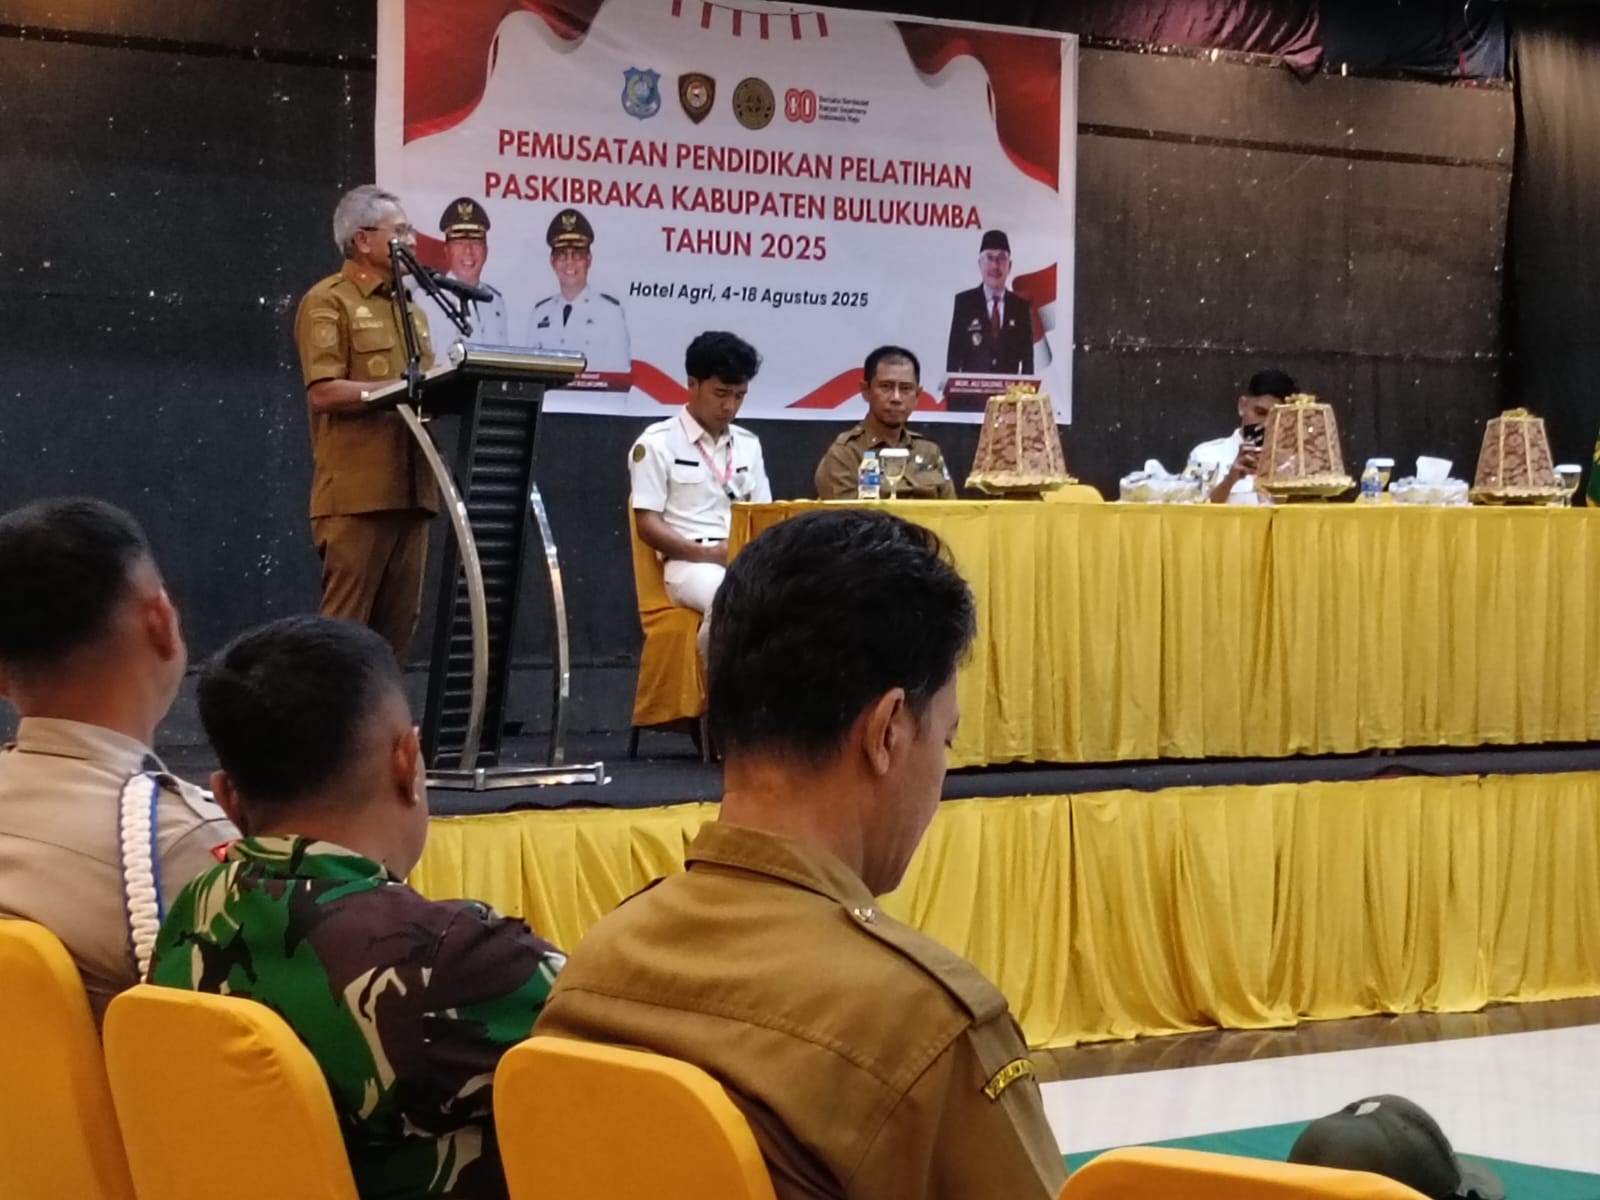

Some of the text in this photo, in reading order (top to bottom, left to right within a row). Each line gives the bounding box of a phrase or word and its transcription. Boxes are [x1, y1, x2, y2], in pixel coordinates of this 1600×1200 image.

[784, 87, 817, 124] 80
[498, 128, 972, 190] PEMUSATAN PENDIDIKAN PELATIHAN
[485, 171, 982, 230] PASKIBRAKA KABUPATEN BULUKUMBA
[662, 227, 827, 260] TAHUN 2025
[629, 281, 869, 309] Hotel Agri, 4-18 Agustus 2025
